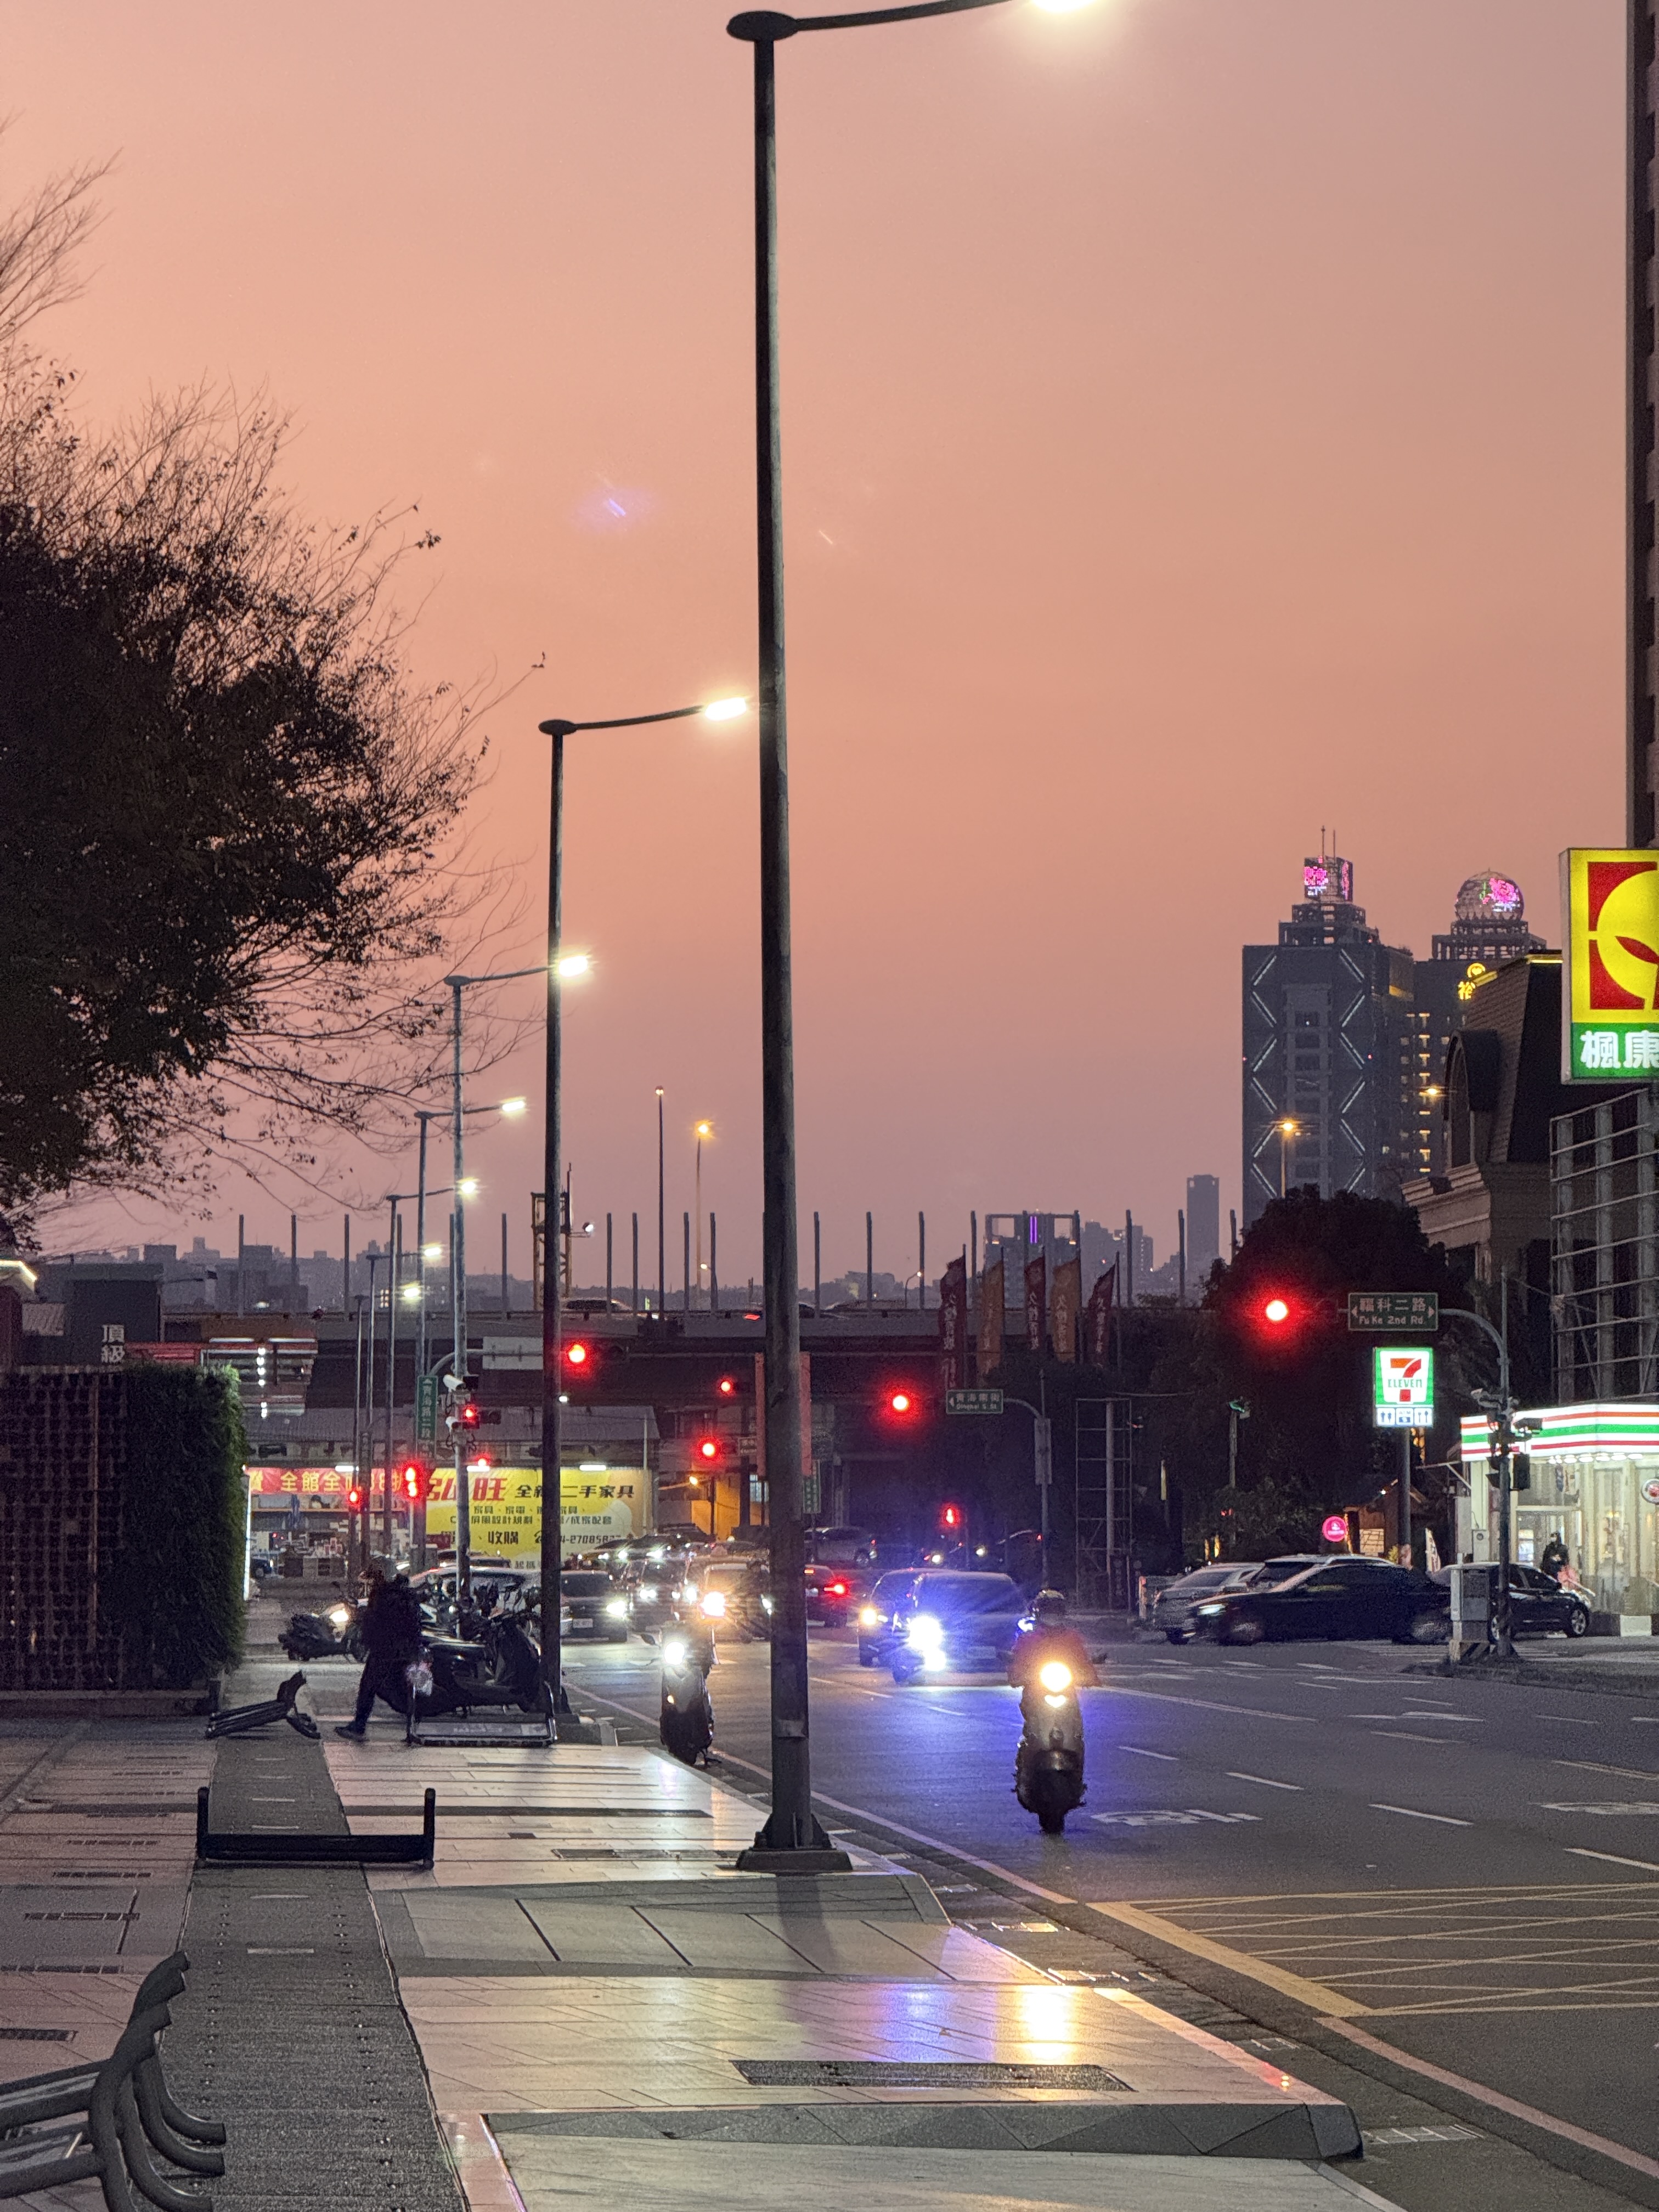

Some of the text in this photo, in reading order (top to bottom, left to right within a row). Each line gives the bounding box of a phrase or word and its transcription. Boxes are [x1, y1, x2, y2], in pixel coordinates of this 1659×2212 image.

[1580, 1029, 1659, 1069] 楓康
[1359, 1297, 1426, 1312] 福科二路
[1387, 1316, 1406, 1325] 2nd
[102, 1324, 125, 1363] 頂級
[1390, 1358, 1421, 1402] 7
